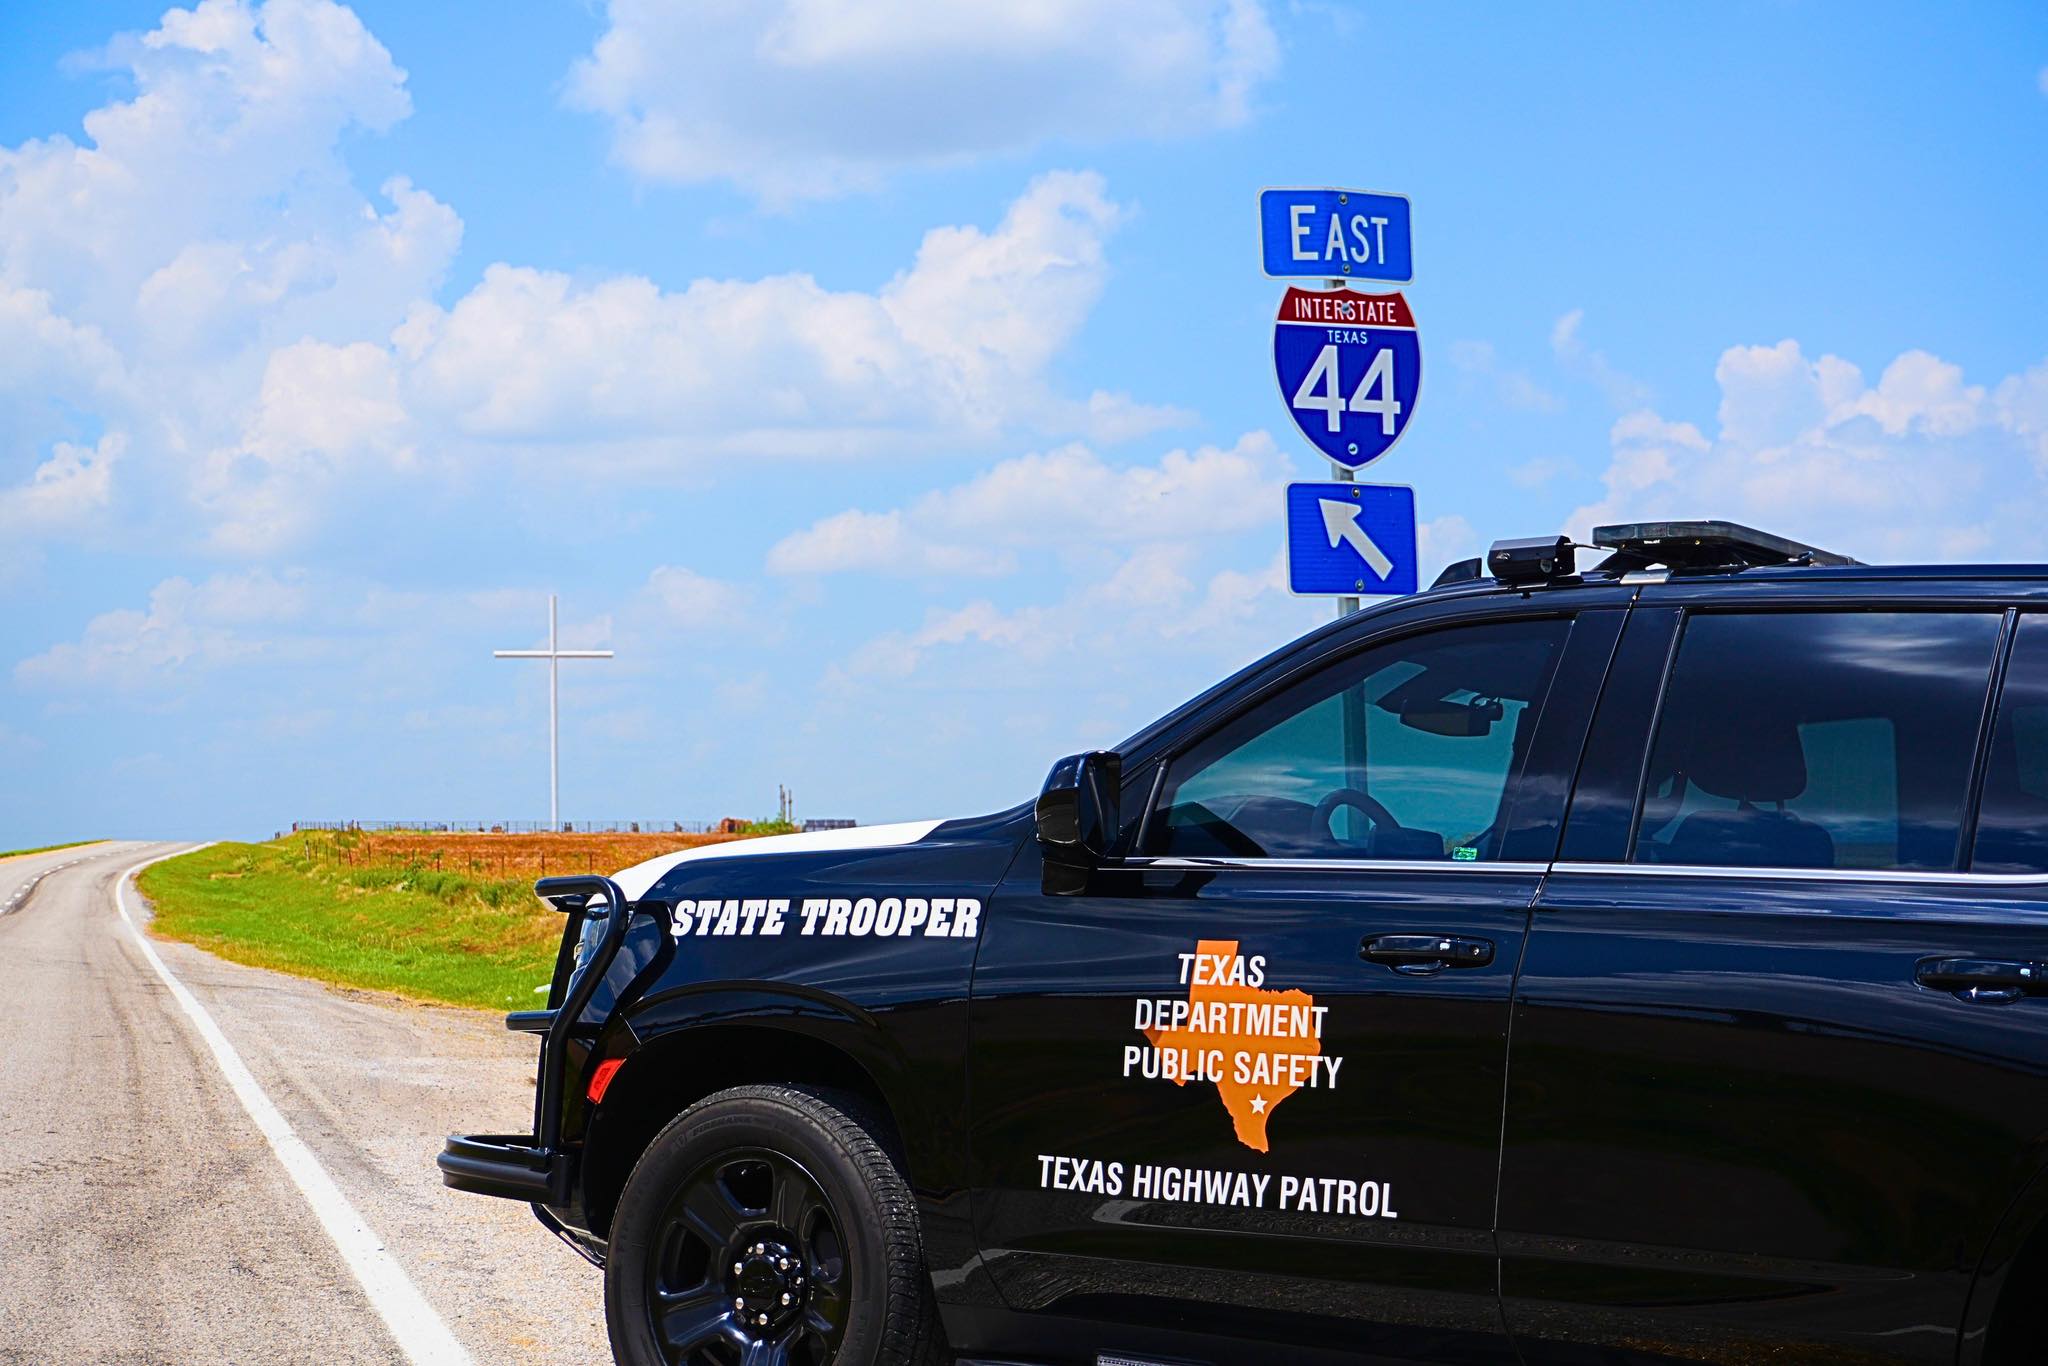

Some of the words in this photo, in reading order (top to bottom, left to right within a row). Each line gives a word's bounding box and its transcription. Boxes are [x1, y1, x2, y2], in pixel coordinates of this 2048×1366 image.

[1290, 205, 1388, 264] EAST
[1295, 297, 1397, 323] INTERSTATE
[1327, 330, 1368, 344] TEXAS
[1293, 345, 1401, 435] 44
[670, 900, 790, 935] STATE
[800, 898, 981, 937] TROOPER
[1178, 953, 1266, 988] TEXAS
[1134, 998, 1328, 1039] DEPARTMENT
[1123, 1045, 1224, 1083] PUBLIC
[1233, 1051, 1343, 1089] SAFETY
[1037, 1154, 1124, 1196] TEXAS
[1132, 1164, 1271, 1208] HIGHWAY
[1279, 1175, 1398, 1219] PATROL
